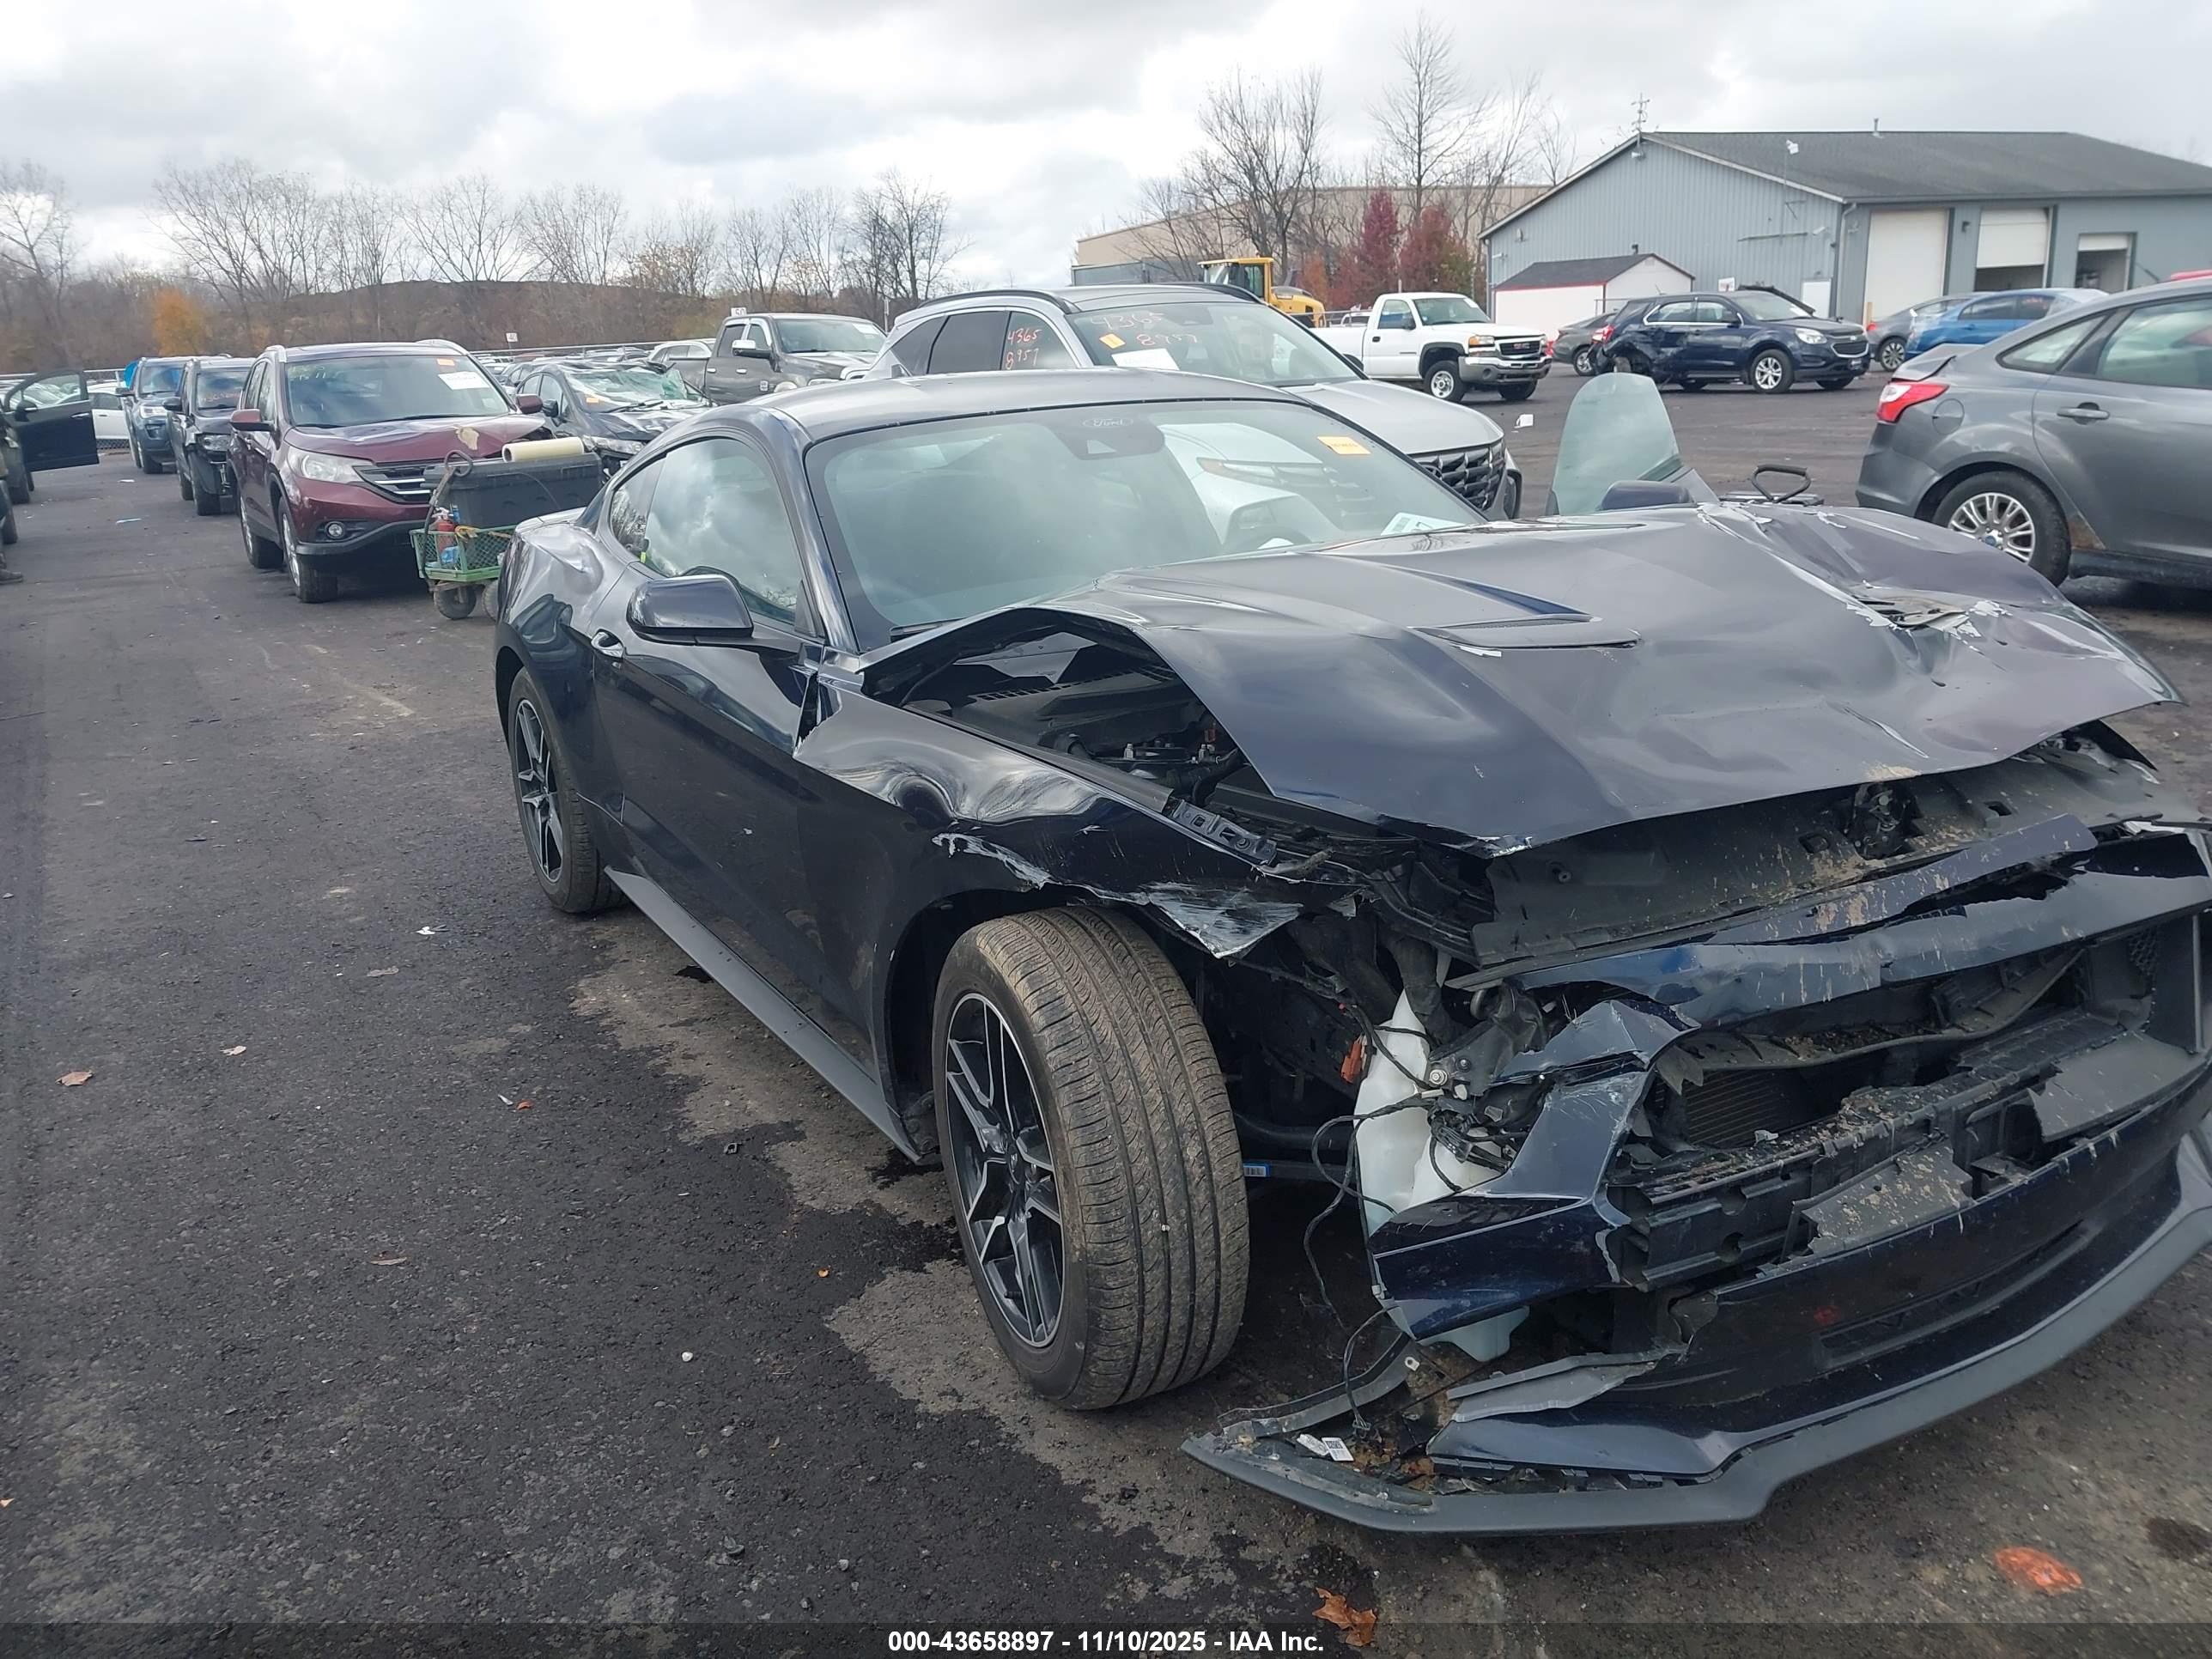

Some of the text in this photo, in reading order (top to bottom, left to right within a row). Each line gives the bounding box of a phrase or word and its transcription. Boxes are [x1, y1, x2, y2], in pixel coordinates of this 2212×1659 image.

[1006, 328, 1042, 344] 4365
[1006, 347, 1039, 371] 8957
[1092, 418, 1124, 428] Ford
